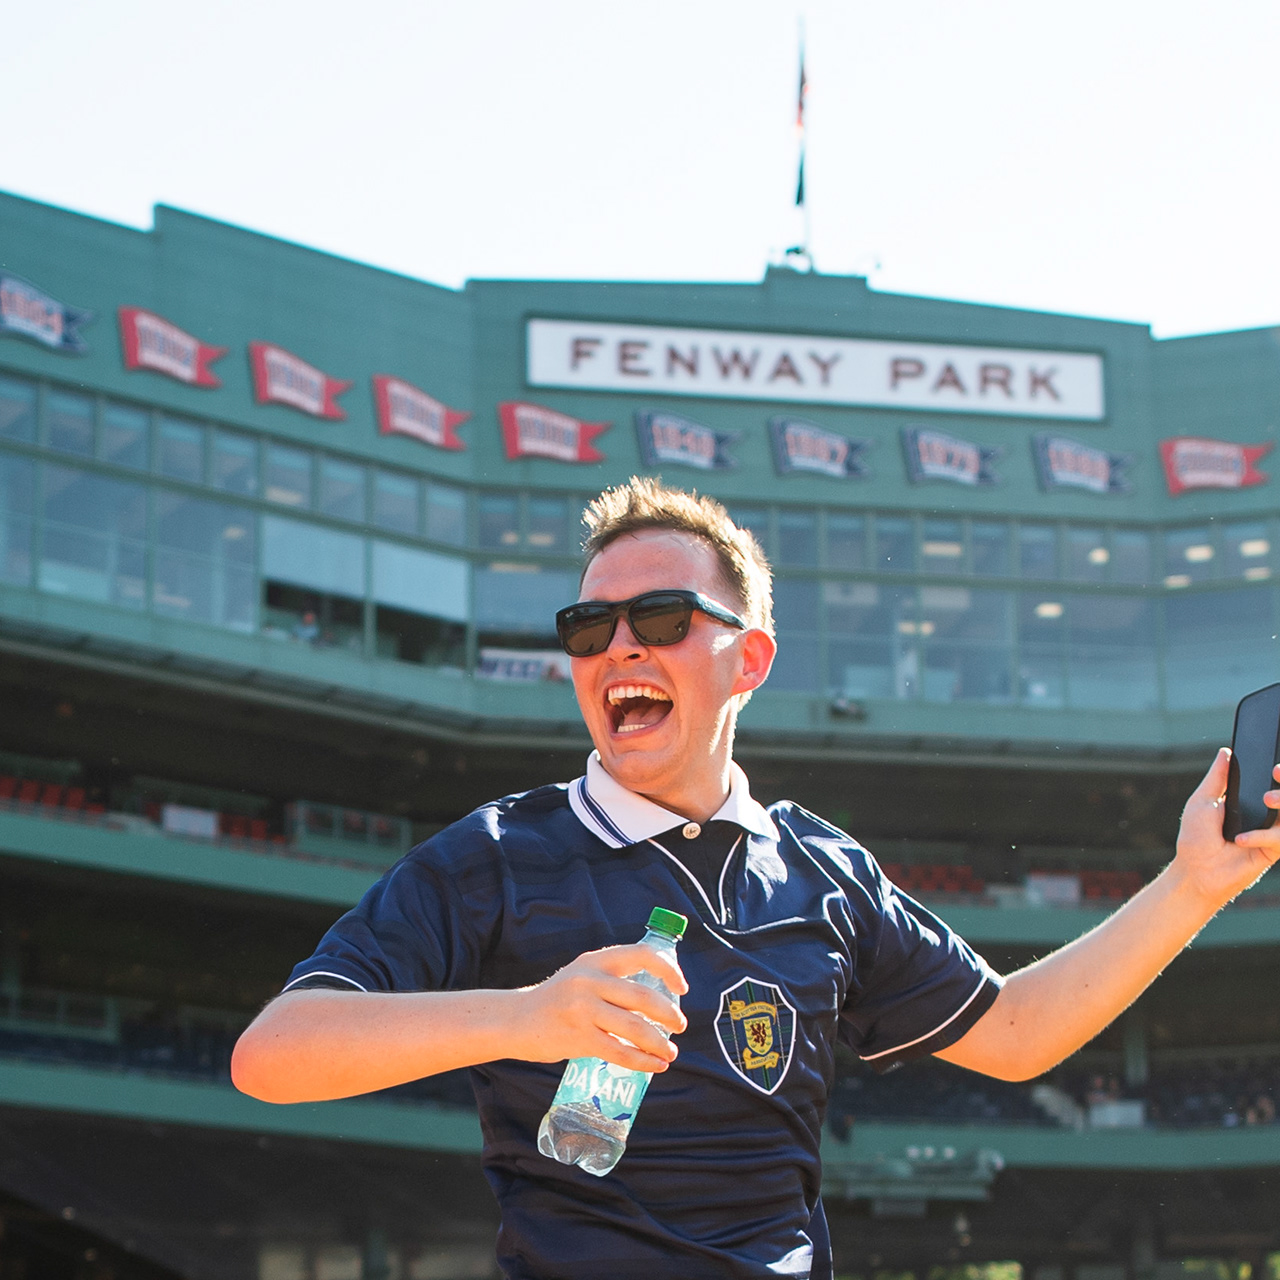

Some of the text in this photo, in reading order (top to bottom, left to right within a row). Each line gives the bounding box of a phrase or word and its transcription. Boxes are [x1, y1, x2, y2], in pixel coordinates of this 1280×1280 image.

[568, 336, 1063, 402] FENWAY PARK
[564, 1062, 637, 1108] DASANI
